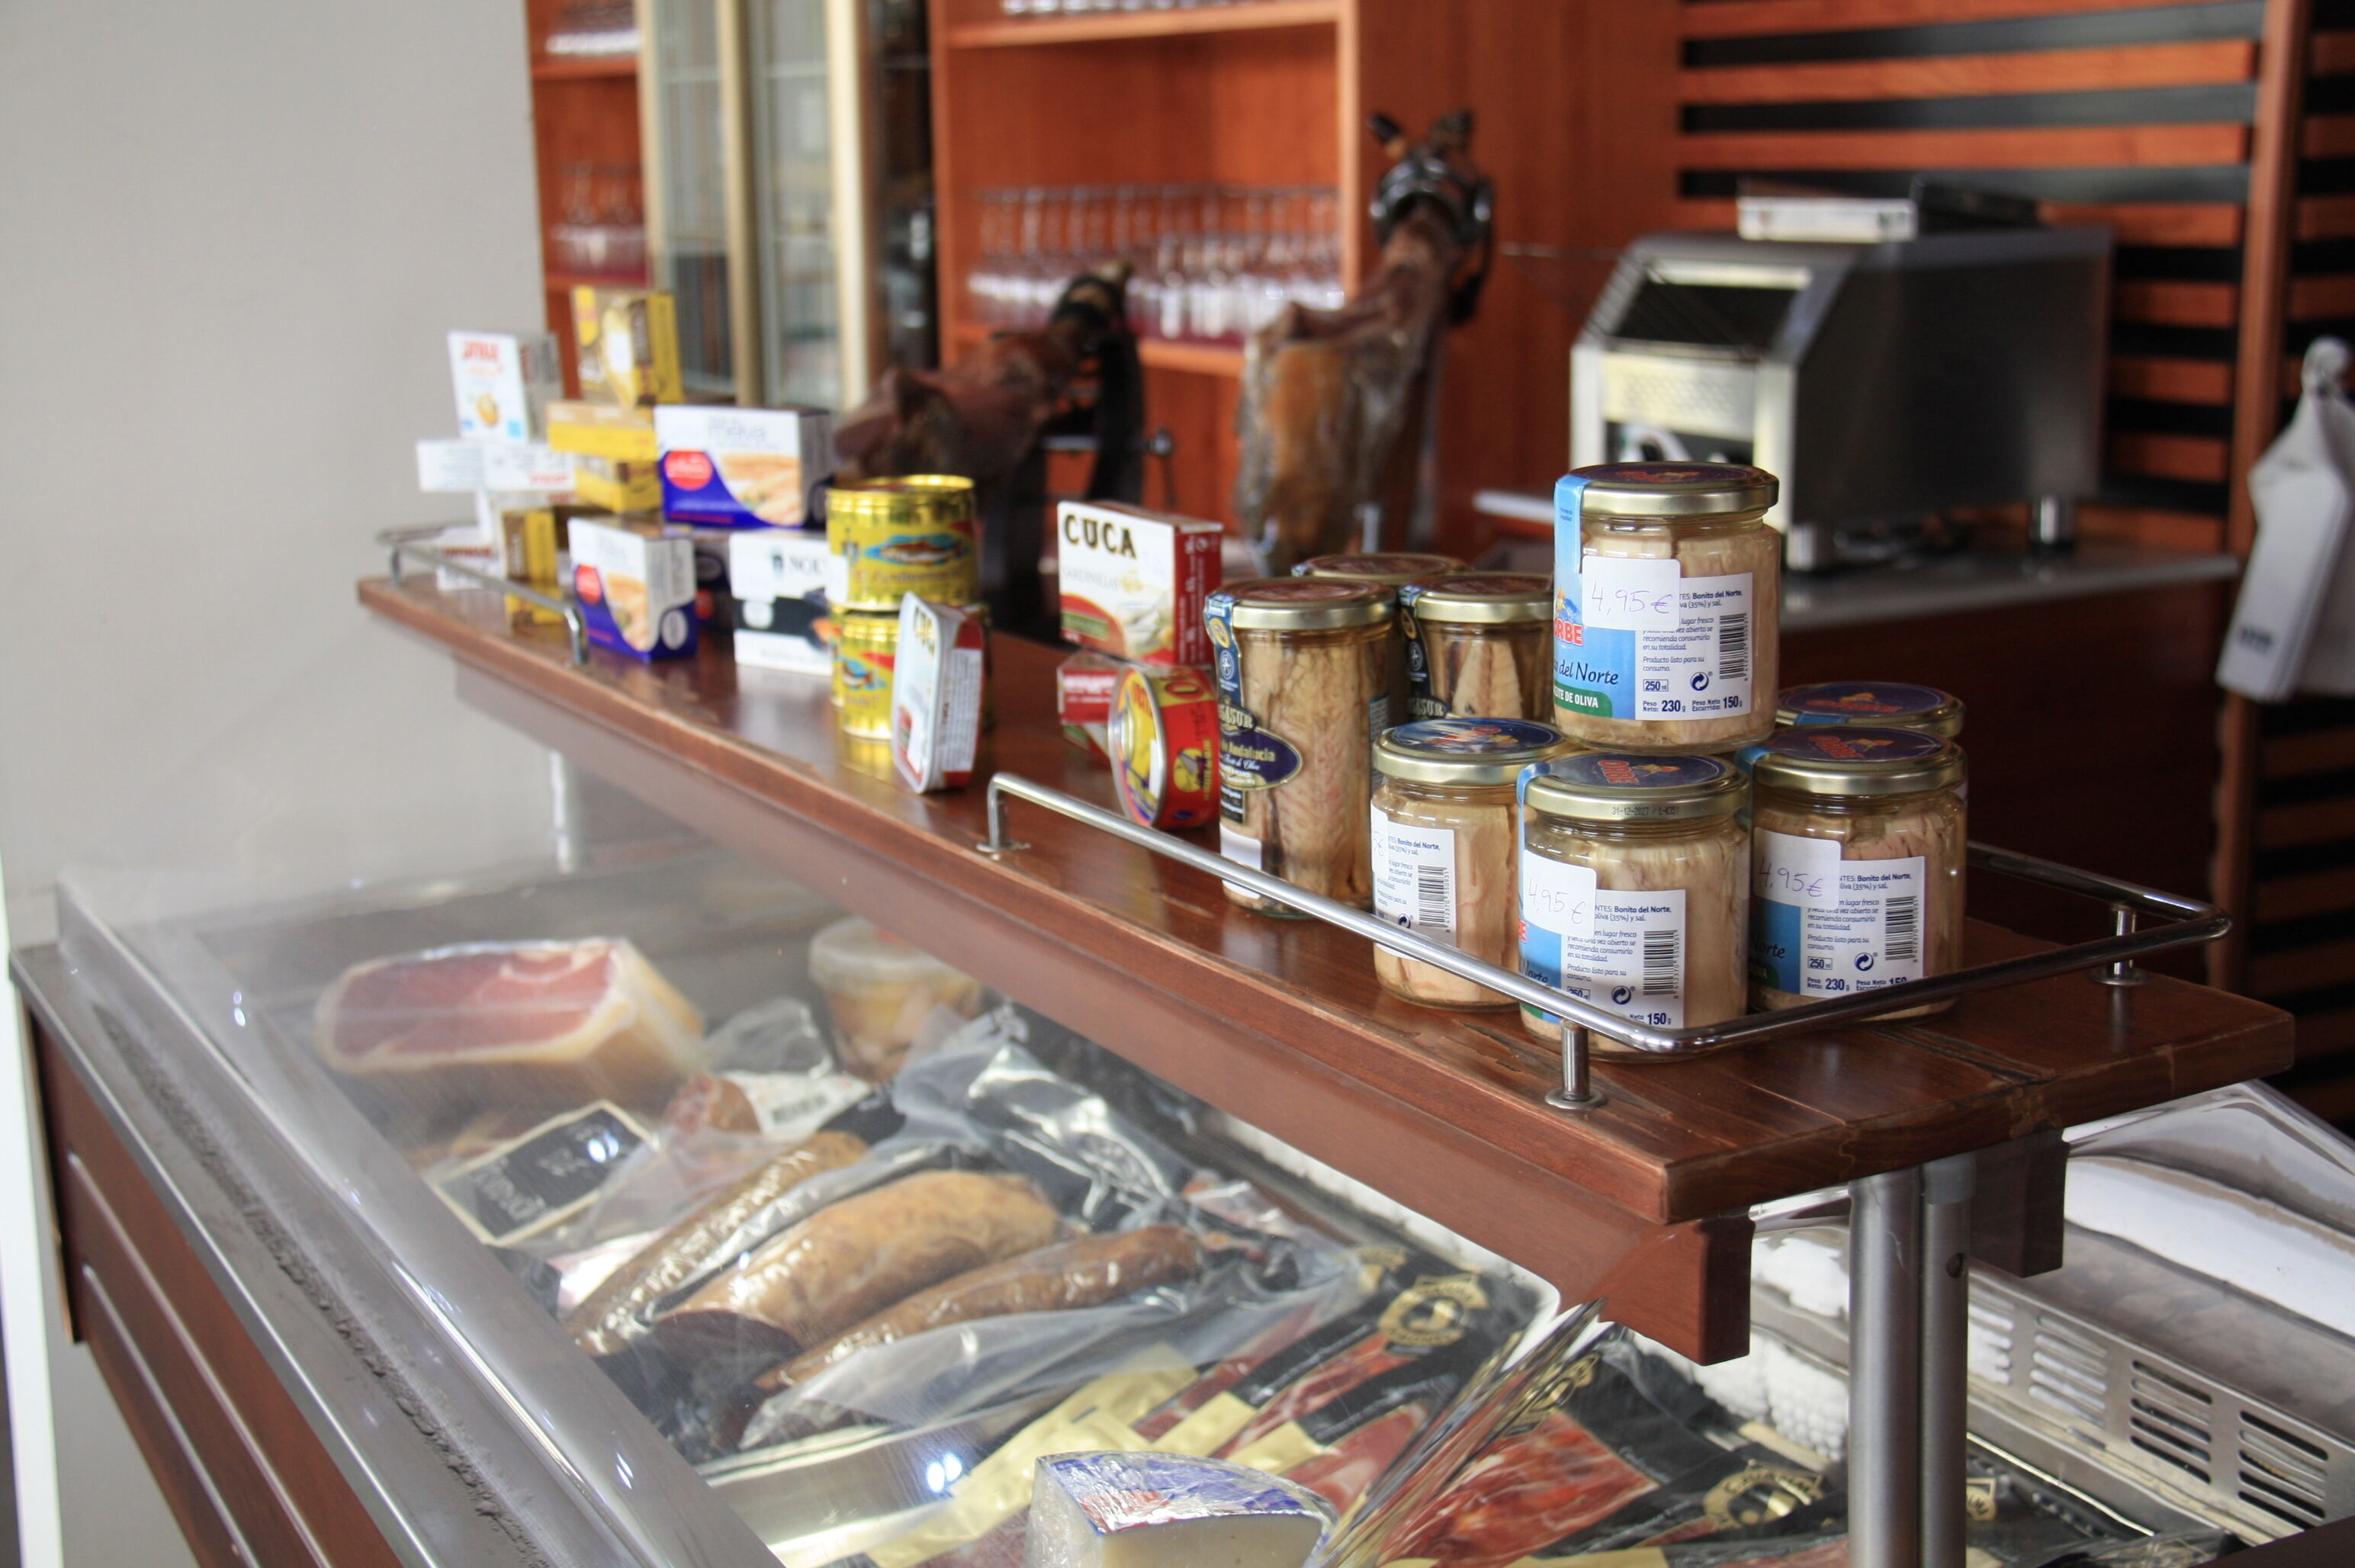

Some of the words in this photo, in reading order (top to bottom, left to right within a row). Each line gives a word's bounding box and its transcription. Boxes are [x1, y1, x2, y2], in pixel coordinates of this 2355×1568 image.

[1064, 514, 1136, 559] CUCA
[1688, 600, 1707, 609] (35%)
[1553, 618, 1584, 647] RBE
[1559, 659, 1573, 677] del
[1575, 661, 1618, 685] Norte
[1645, 681, 1660, 691] 250
[1565, 690, 1573, 703] DE
[1574, 694, 1599, 708] OLIVA
[1723, 696, 1739, 708] 150
[1661, 700, 1681, 712] 230
[1422, 842, 1441, 850] Norte,
[1881, 873, 1891, 882] del
[1852, 882, 1871, 891] (35%)
[1846, 899, 1862, 908] lugar
[1610, 914, 1629, 922] (35%)
[1602, 930, 1618, 938] lugar
[1618, 930, 1637, 939] fresco
[1807, 934, 1833, 943] Producto
[1567, 943, 1599, 953] recomienda
[1599, 946, 1633, 955] consumirlo
[1581, 953, 1608, 962] totalidad.
[1810, 959, 1824, 969] 250
[1567, 963, 1591, 974] Producto
[1604, 969, 1618, 977] para
[1567, 973, 1592, 982] consumo.
[1826, 978, 1845, 991] 230
[1647, 1012, 1666, 1026] 150
[1667, 1017, 1671, 1026] g
